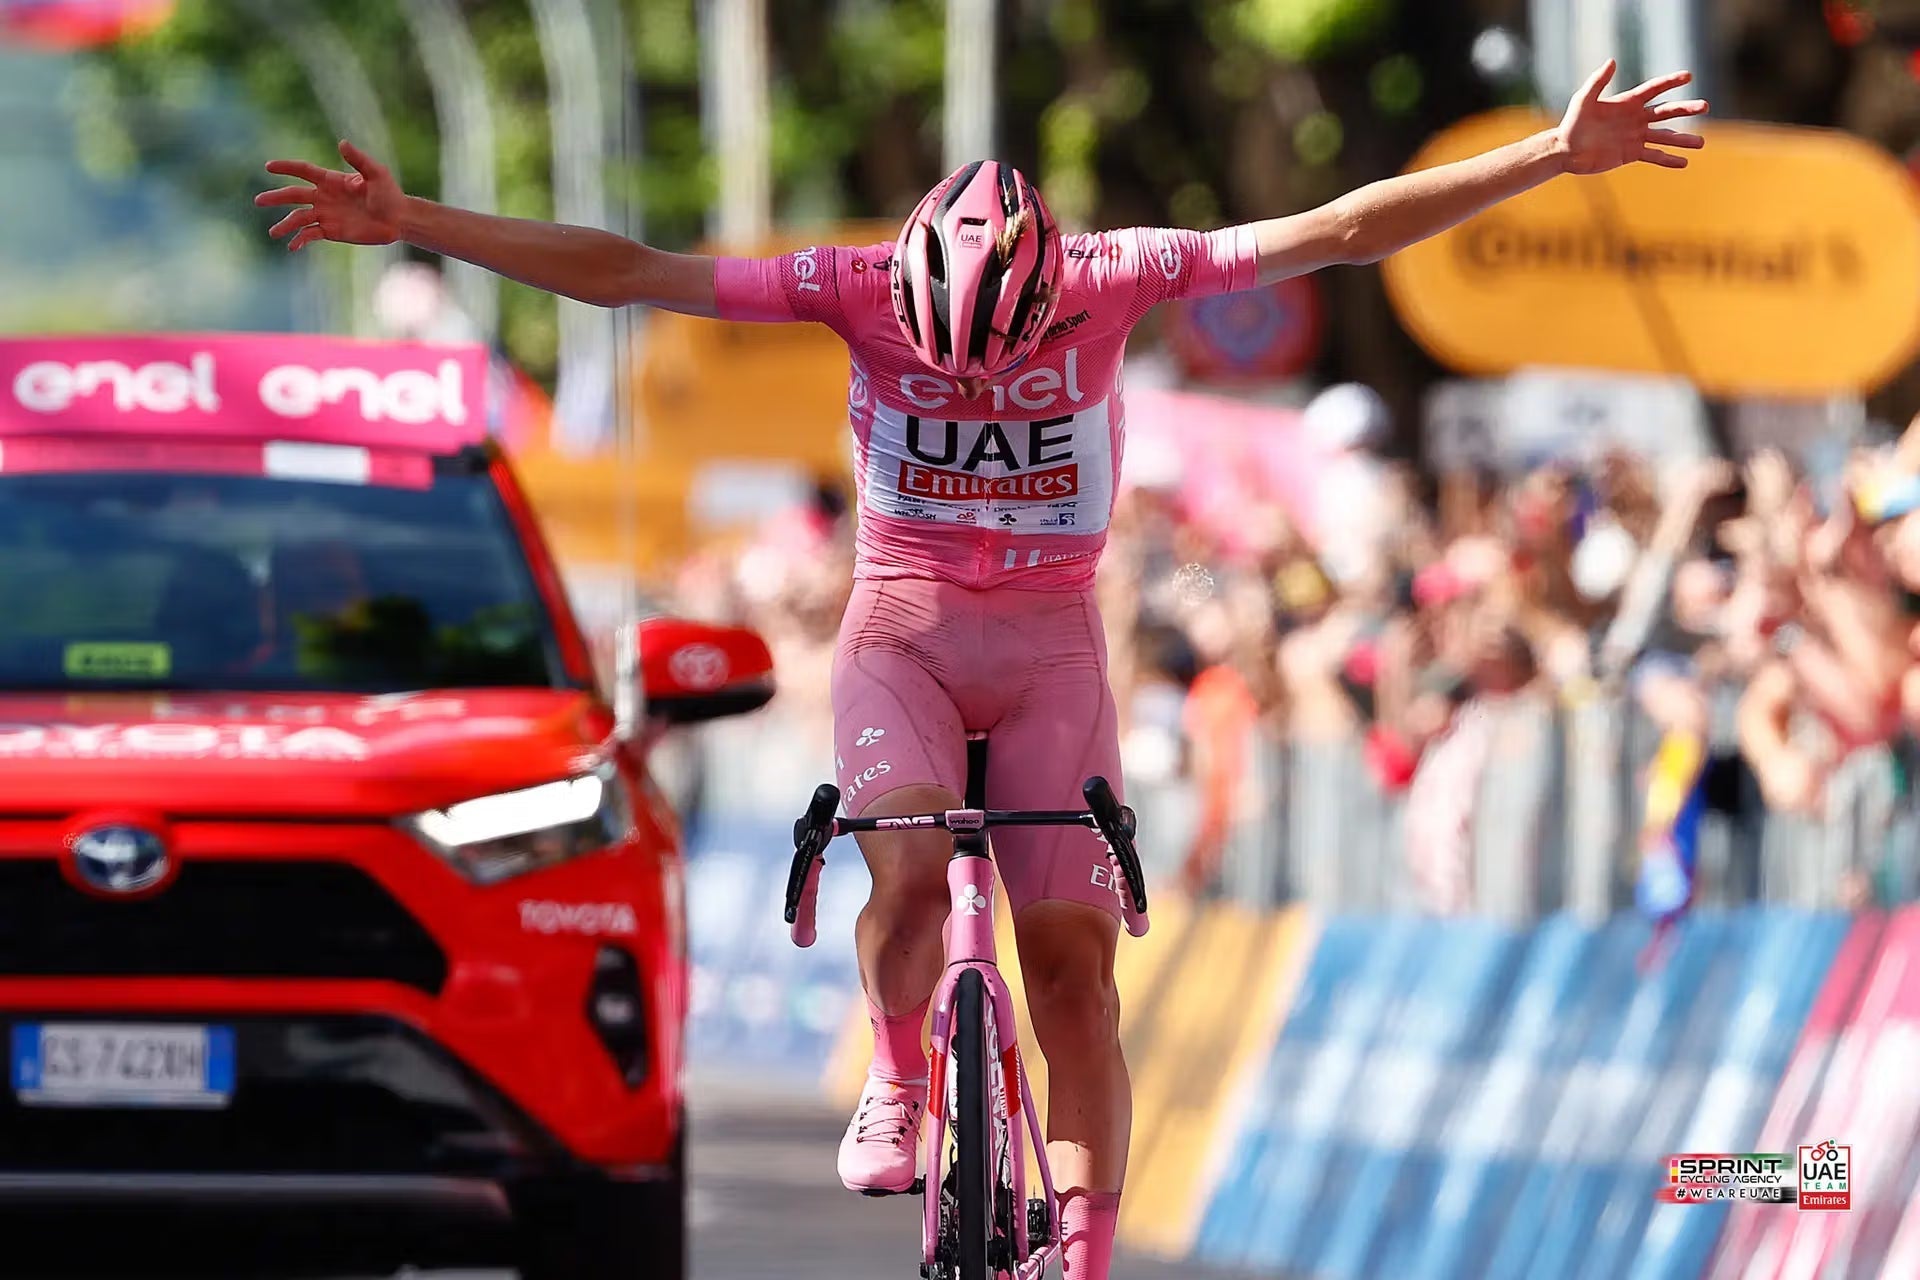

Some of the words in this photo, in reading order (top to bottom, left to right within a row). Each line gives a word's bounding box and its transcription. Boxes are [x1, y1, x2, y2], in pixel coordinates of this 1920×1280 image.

[960, 233, 982, 242] UAE
[1065, 308, 1092, 329] Sport
[14, 353, 219, 412] enel
[259, 360, 467, 426] enel
[906, 414, 1075, 472] UAE
[905, 464, 1074, 497] Emirates
[518, 899, 638, 936] TOYOTA
